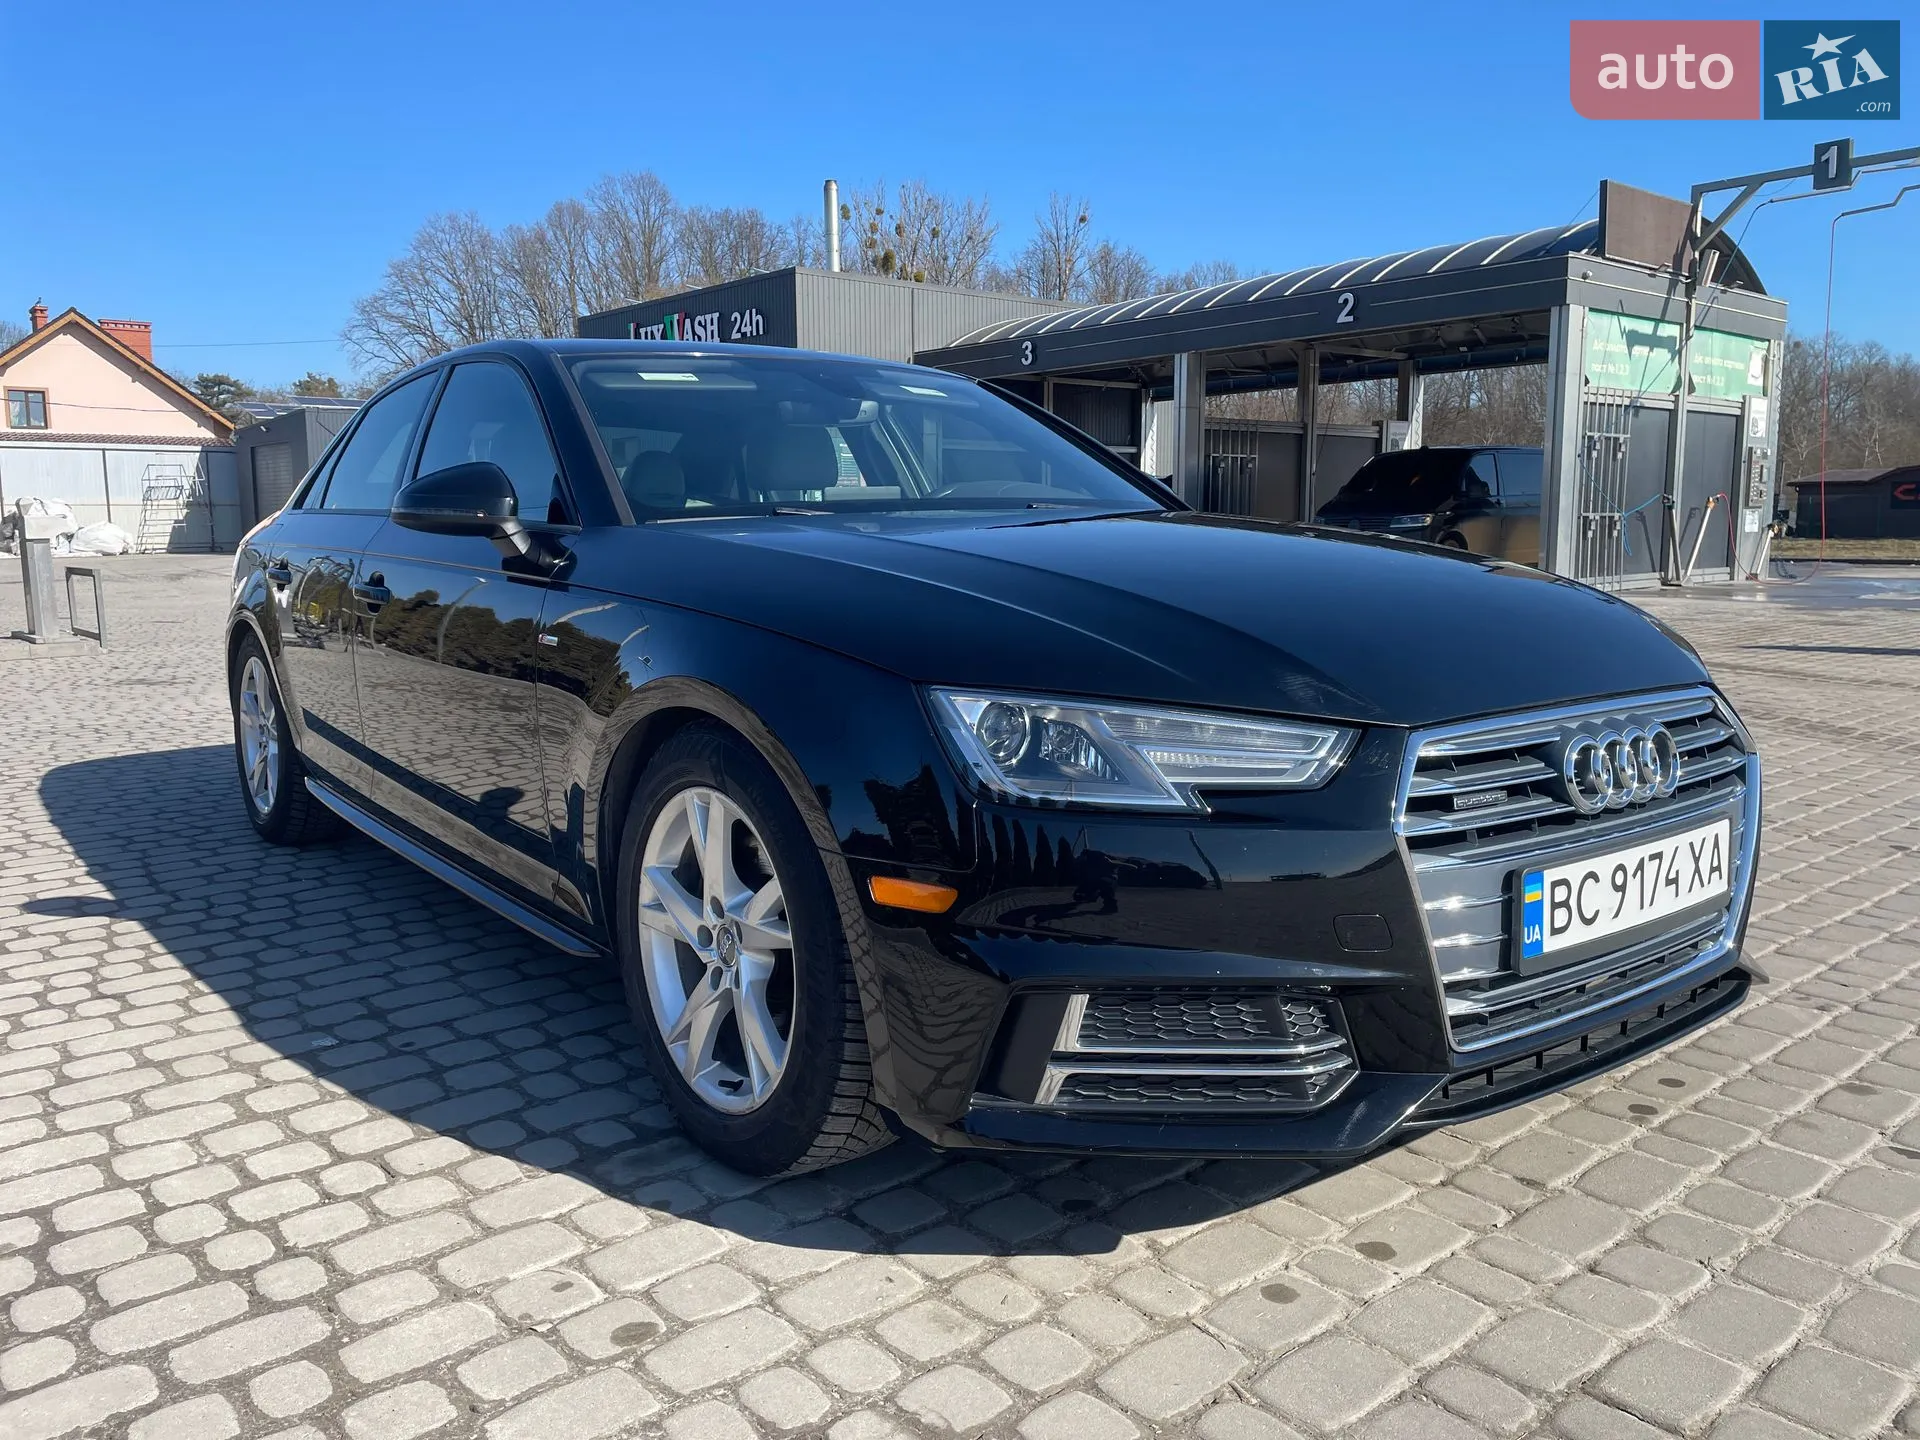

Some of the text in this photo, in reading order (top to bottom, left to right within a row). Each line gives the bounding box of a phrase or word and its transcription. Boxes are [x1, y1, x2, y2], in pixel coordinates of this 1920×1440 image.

[1820, 145, 1839, 179] 1
[730, 308, 764, 340] 24h
[1336, 292, 1356, 324] 2
[1020, 340, 1034, 366] 3
[1550, 833, 1723, 936] BC 9174 XA
[1524, 924, 1542, 944] UA
